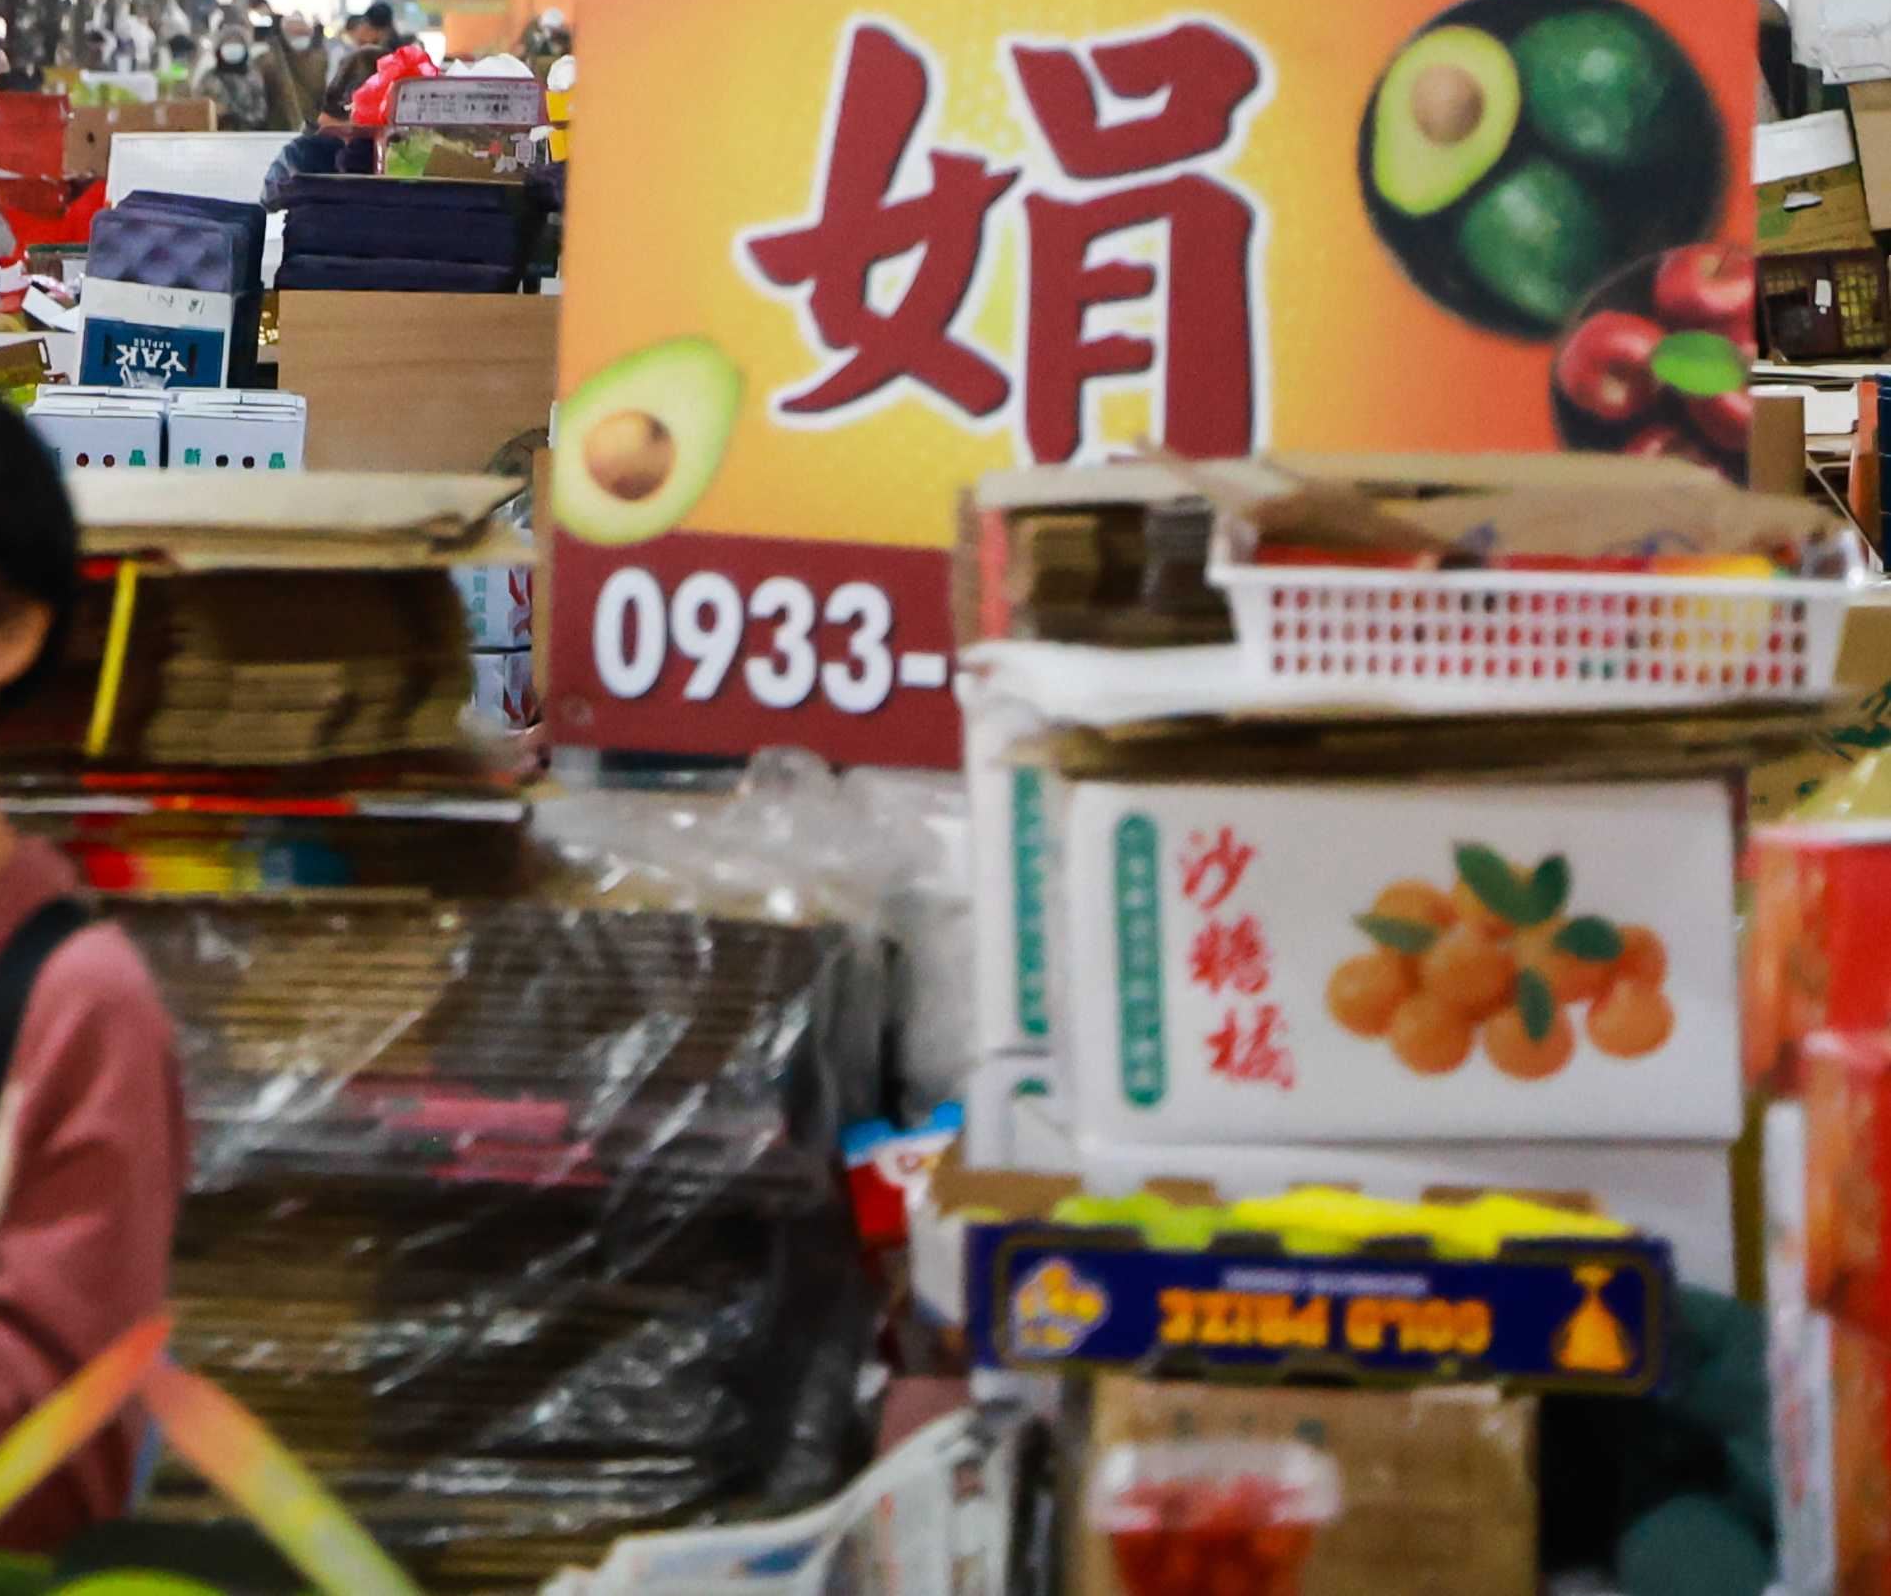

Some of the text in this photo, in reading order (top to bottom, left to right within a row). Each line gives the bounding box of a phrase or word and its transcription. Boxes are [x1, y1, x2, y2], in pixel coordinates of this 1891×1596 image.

[750, 24, 1258, 464] 娟
[115, 344, 188, 373] YAK
[594, 567, 950, 714] 0933-
[1158, 1287, 1492, 1352] GOLD PRIZE
